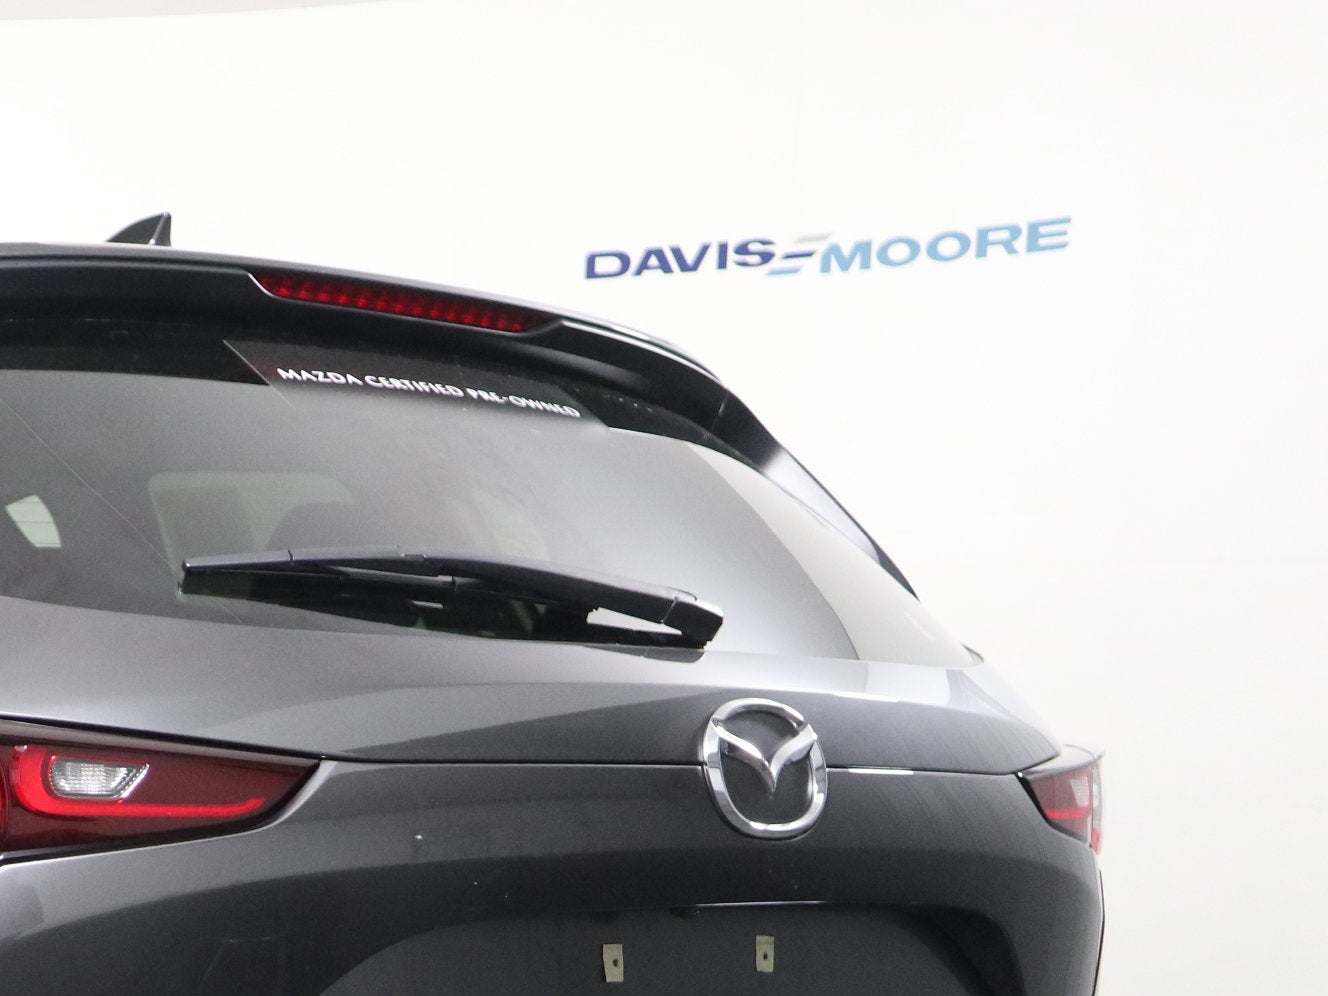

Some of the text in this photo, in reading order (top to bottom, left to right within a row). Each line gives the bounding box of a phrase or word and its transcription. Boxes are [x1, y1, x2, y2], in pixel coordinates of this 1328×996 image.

[584, 215, 1072, 280] DAVIS MOORE
[276, 366, 581, 419] MAZDA CERTIFIED PRE-OWNED
